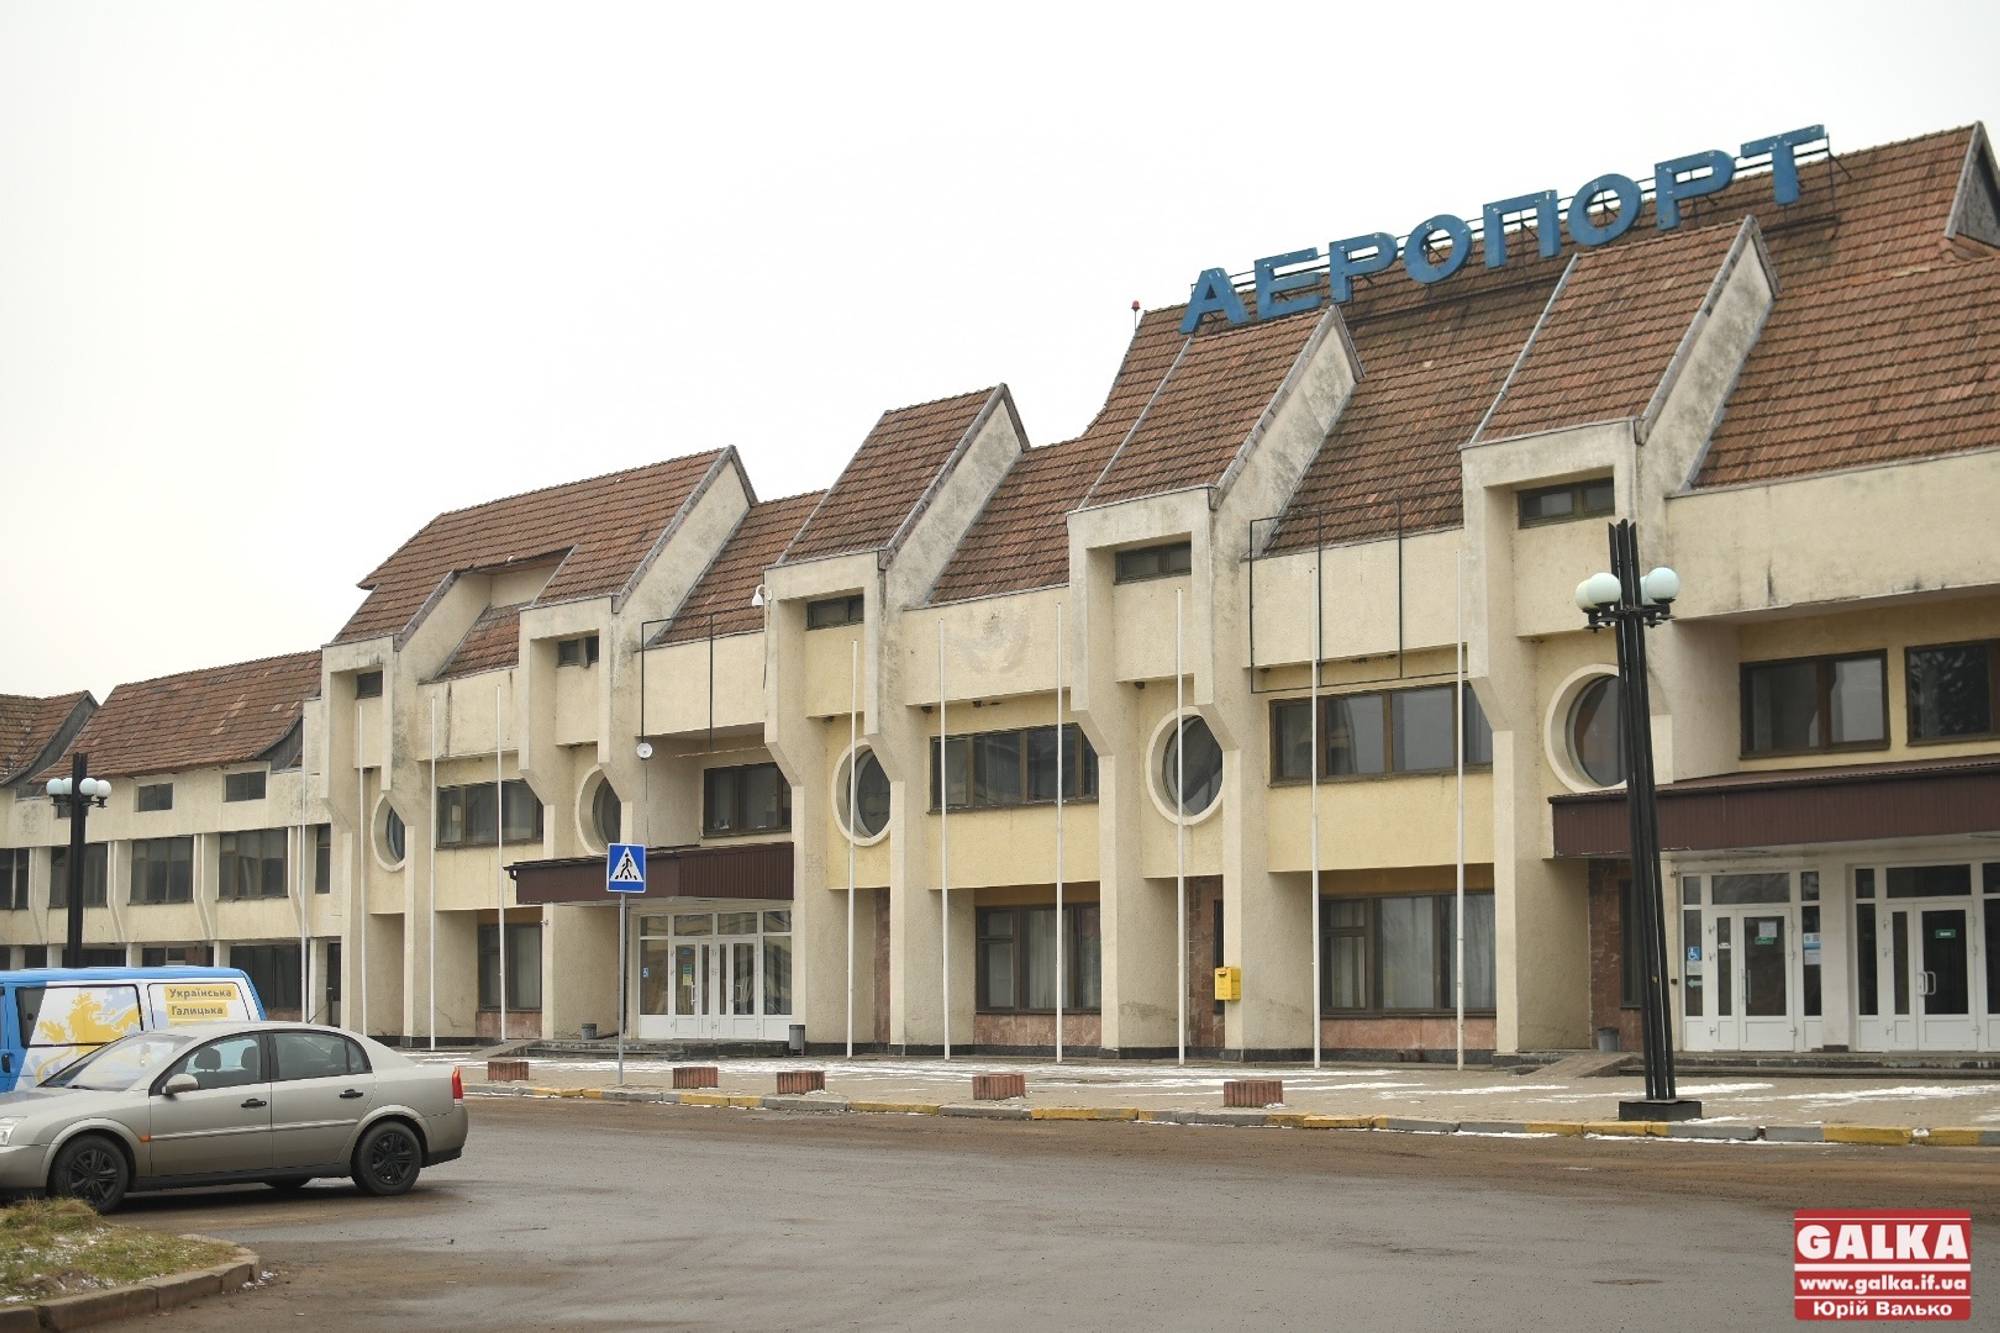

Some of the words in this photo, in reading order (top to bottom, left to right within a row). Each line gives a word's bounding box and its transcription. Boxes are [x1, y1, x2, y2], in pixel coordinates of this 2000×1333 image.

[1180, 124, 1825, 334] АЕРОПОРТ
[169, 987, 231, 999] Українська
[171, 1005, 223, 1016] Галицька
